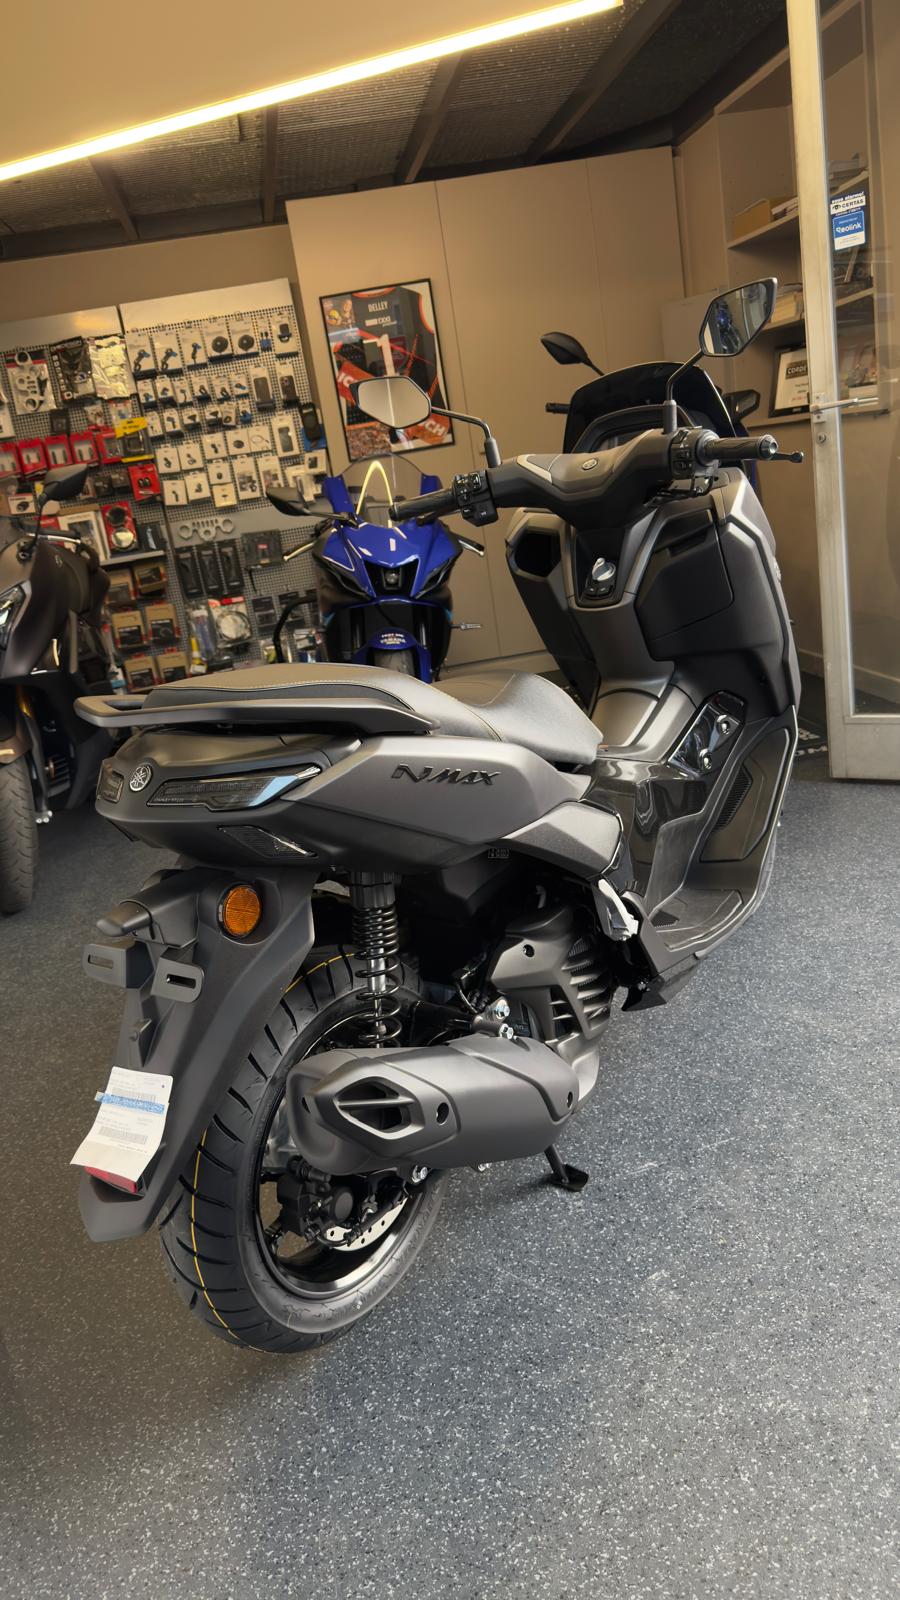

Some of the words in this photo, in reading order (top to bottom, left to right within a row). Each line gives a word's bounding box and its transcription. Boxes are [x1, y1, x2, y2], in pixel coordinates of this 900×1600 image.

[841, 199, 864, 209] CERTAS
[367, 301, 388, 312] DELLEY
[391, 763, 501, 786] NMAX
